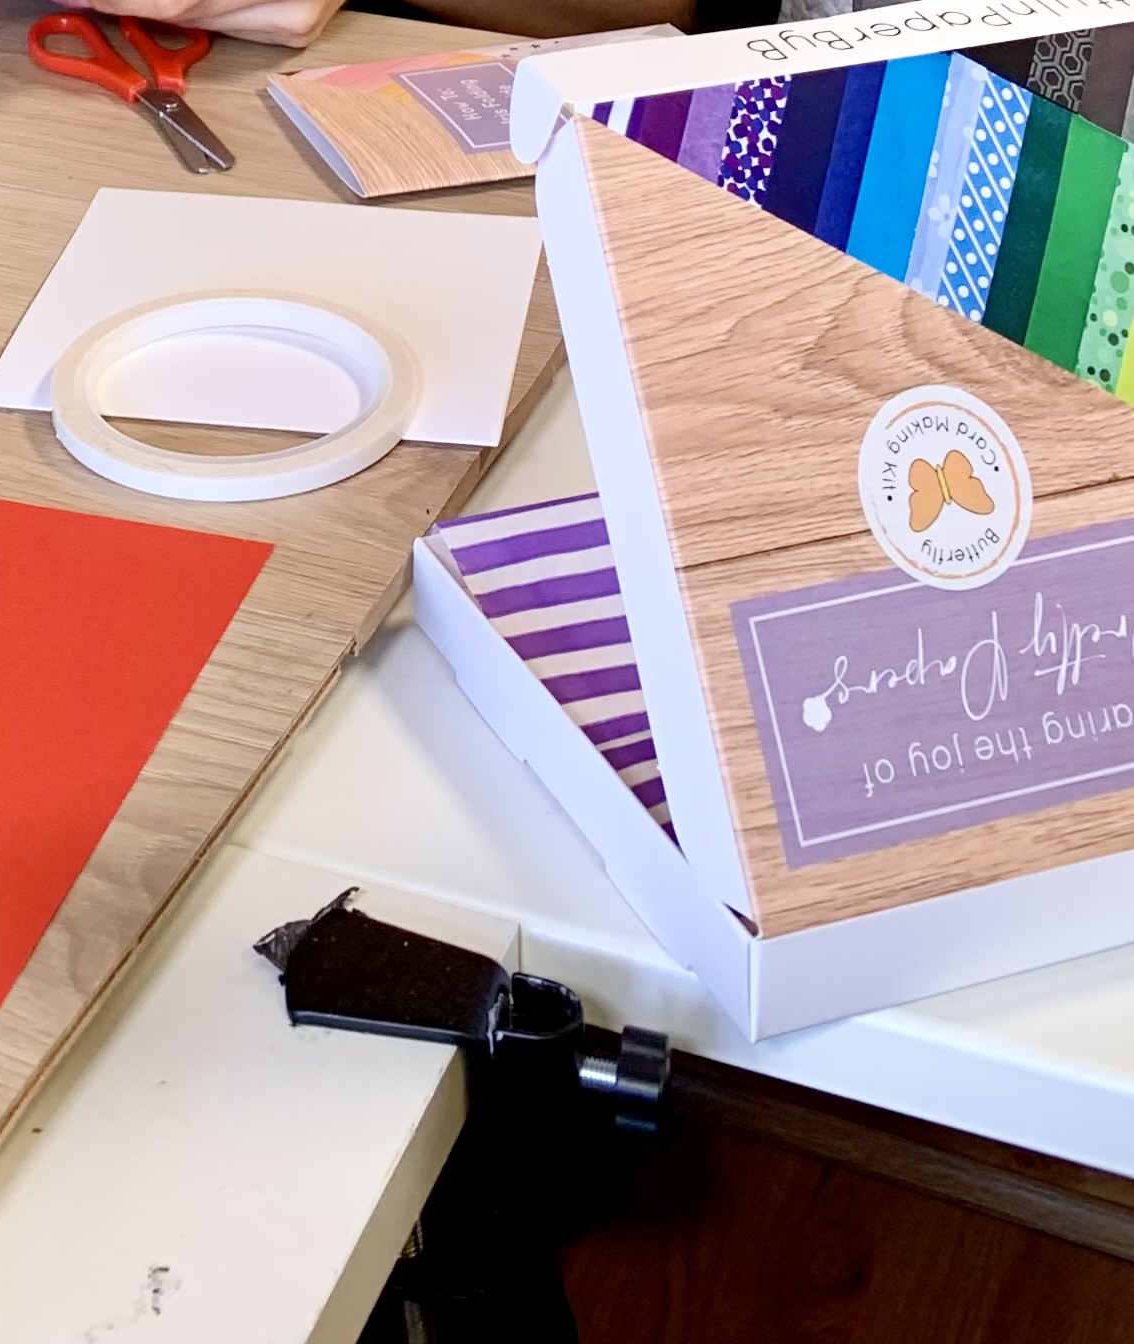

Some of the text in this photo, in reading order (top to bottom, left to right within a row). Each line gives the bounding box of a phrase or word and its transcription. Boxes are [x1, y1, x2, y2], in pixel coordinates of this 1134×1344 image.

[453, 101, 482, 121] How
[460, 79, 502, 109] Folding
[882, 415, 997, 491] Card Making Kit
[920, 527, 1001, 565] Butterfly
[822, 610, 1009, 722] Papers
[908, 733, 965, 776] joy
[974, 727, 1032, 763] the
[863, 758, 895, 798] of
